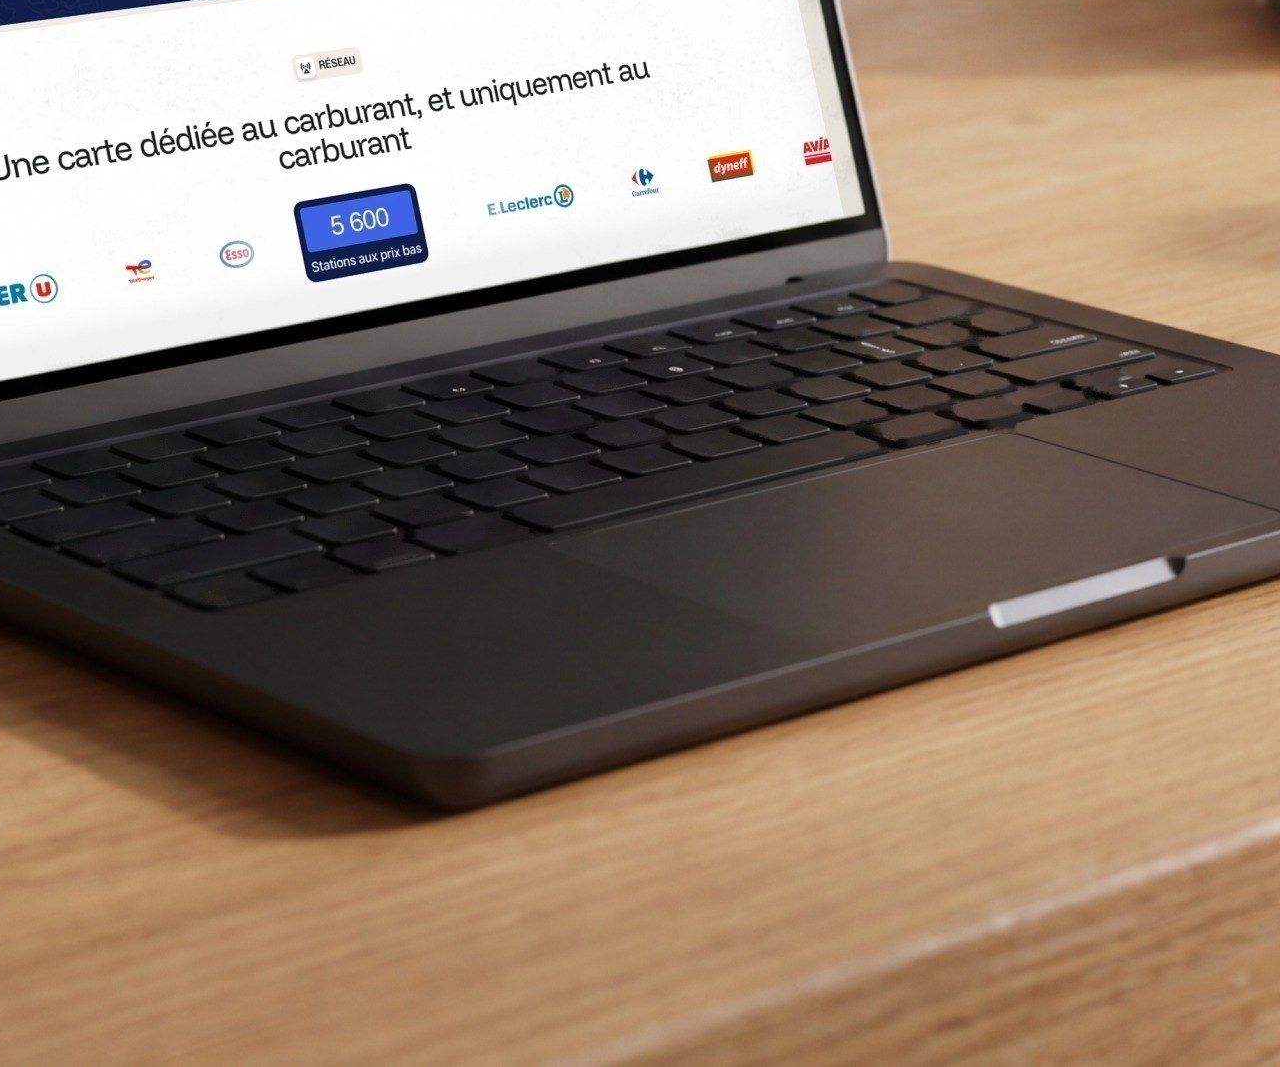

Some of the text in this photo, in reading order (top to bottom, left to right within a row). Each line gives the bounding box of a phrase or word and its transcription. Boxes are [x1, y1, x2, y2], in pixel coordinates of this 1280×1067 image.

[318, 55, 356, 70] RÉSEAU
[58, 138, 133, 171] carte
[140, 121, 235, 158] dédiée
[242, 118, 278, 142] au
[284, 92, 423, 135] carburant,
[428, 87, 455, 112] et
[460, 62, 614, 106] uniquement
[618, 60, 651, 82] au
[279, 126, 412, 170] carburant
[714, 157, 748, 175] dyneff
[631, 187, 660, 198] Carrefour
[330, 207, 389, 235] 5 600
[311, 244, 422, 273] Stations aux prix bas
[35, 281, 52, 297] U
